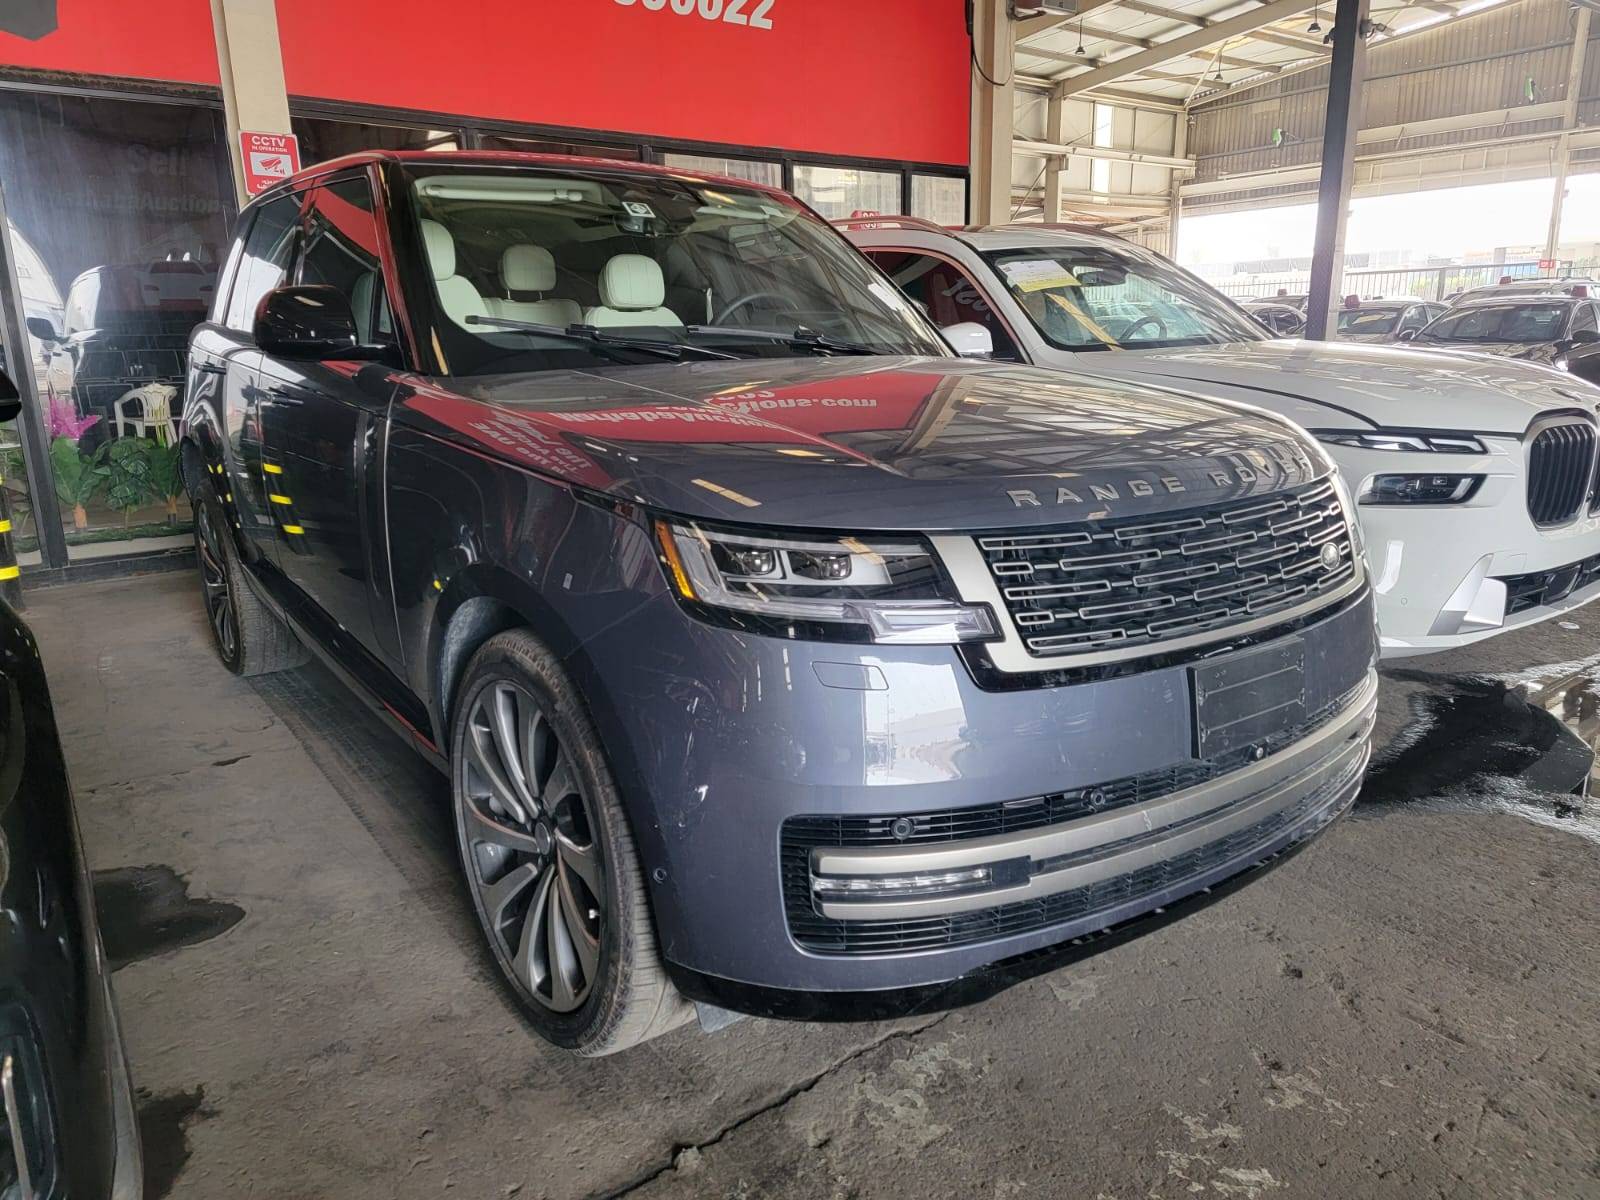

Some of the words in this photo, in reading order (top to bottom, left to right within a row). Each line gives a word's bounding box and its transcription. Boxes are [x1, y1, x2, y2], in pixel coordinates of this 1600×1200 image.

[251, 135, 285, 147] CCTV
[1006, 476, 1187, 508] RANGE
[1207, 453, 1310, 487] ROVER
